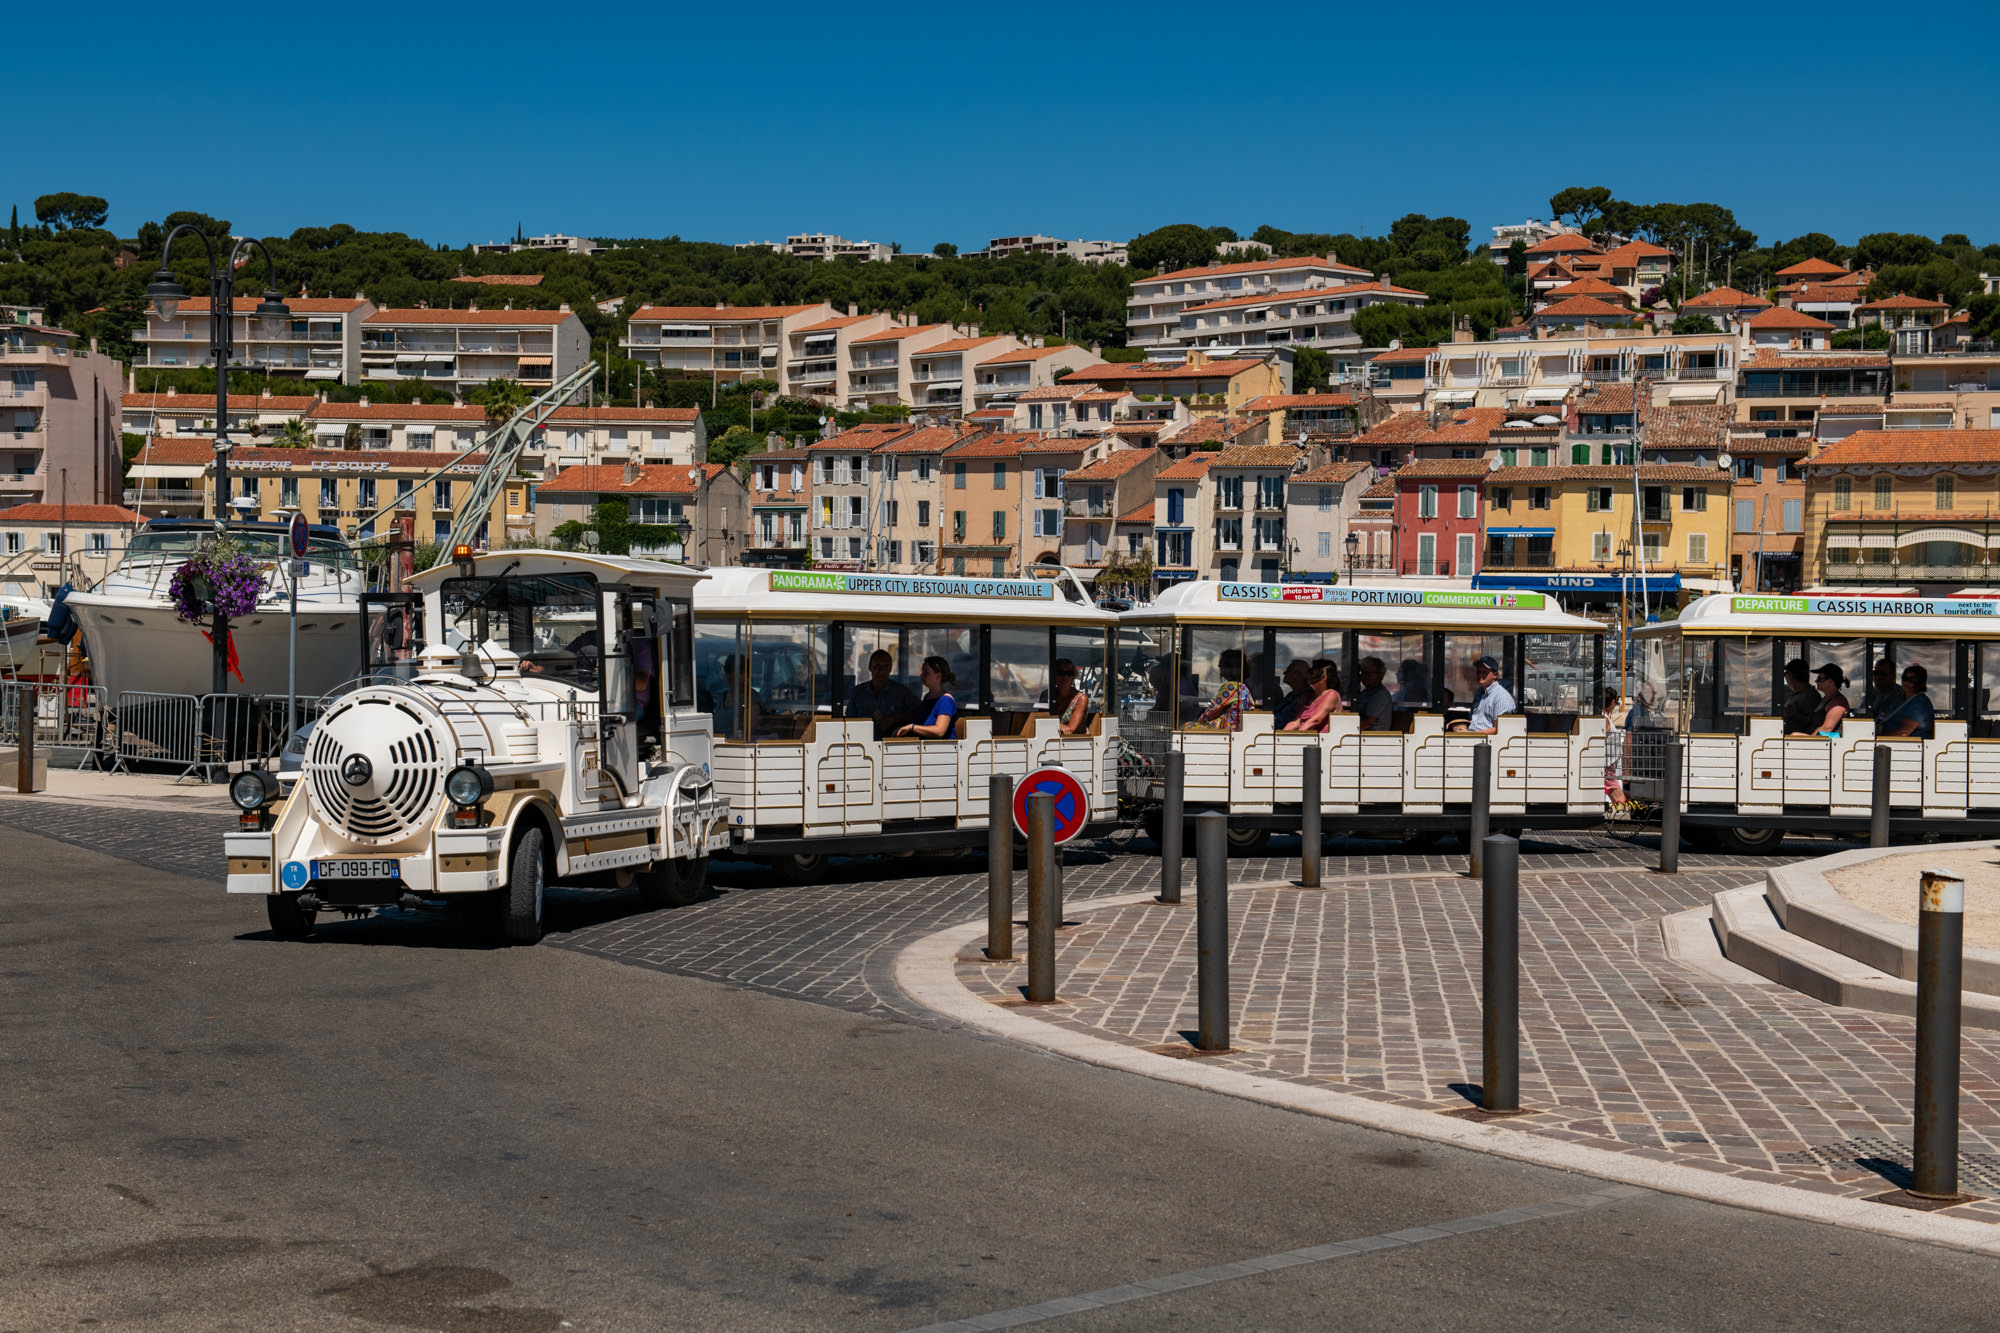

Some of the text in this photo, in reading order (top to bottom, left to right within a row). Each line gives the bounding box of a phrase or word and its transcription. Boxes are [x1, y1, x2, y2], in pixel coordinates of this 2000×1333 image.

[311, 461, 389, 471] LE GOLFE
[773, 574, 833, 589] PANORAMA
[848, 578, 882, 591] UPPER
[974, 583, 994, 595] CAP
[996, 584, 1042, 597] CANAILLE
[1547, 577, 1595, 587] NINO
[1222, 584, 1268, 599] CASSIS
[1283, 586, 1322, 596] photo break
[1351, 590, 1423, 605] PORT MIOU
[1426, 594, 1491, 605] COMMENTARY
[1736, 599, 1803, 610] DEPARTURE
[1817, 600, 1934, 614] CASSIS HARBOR
